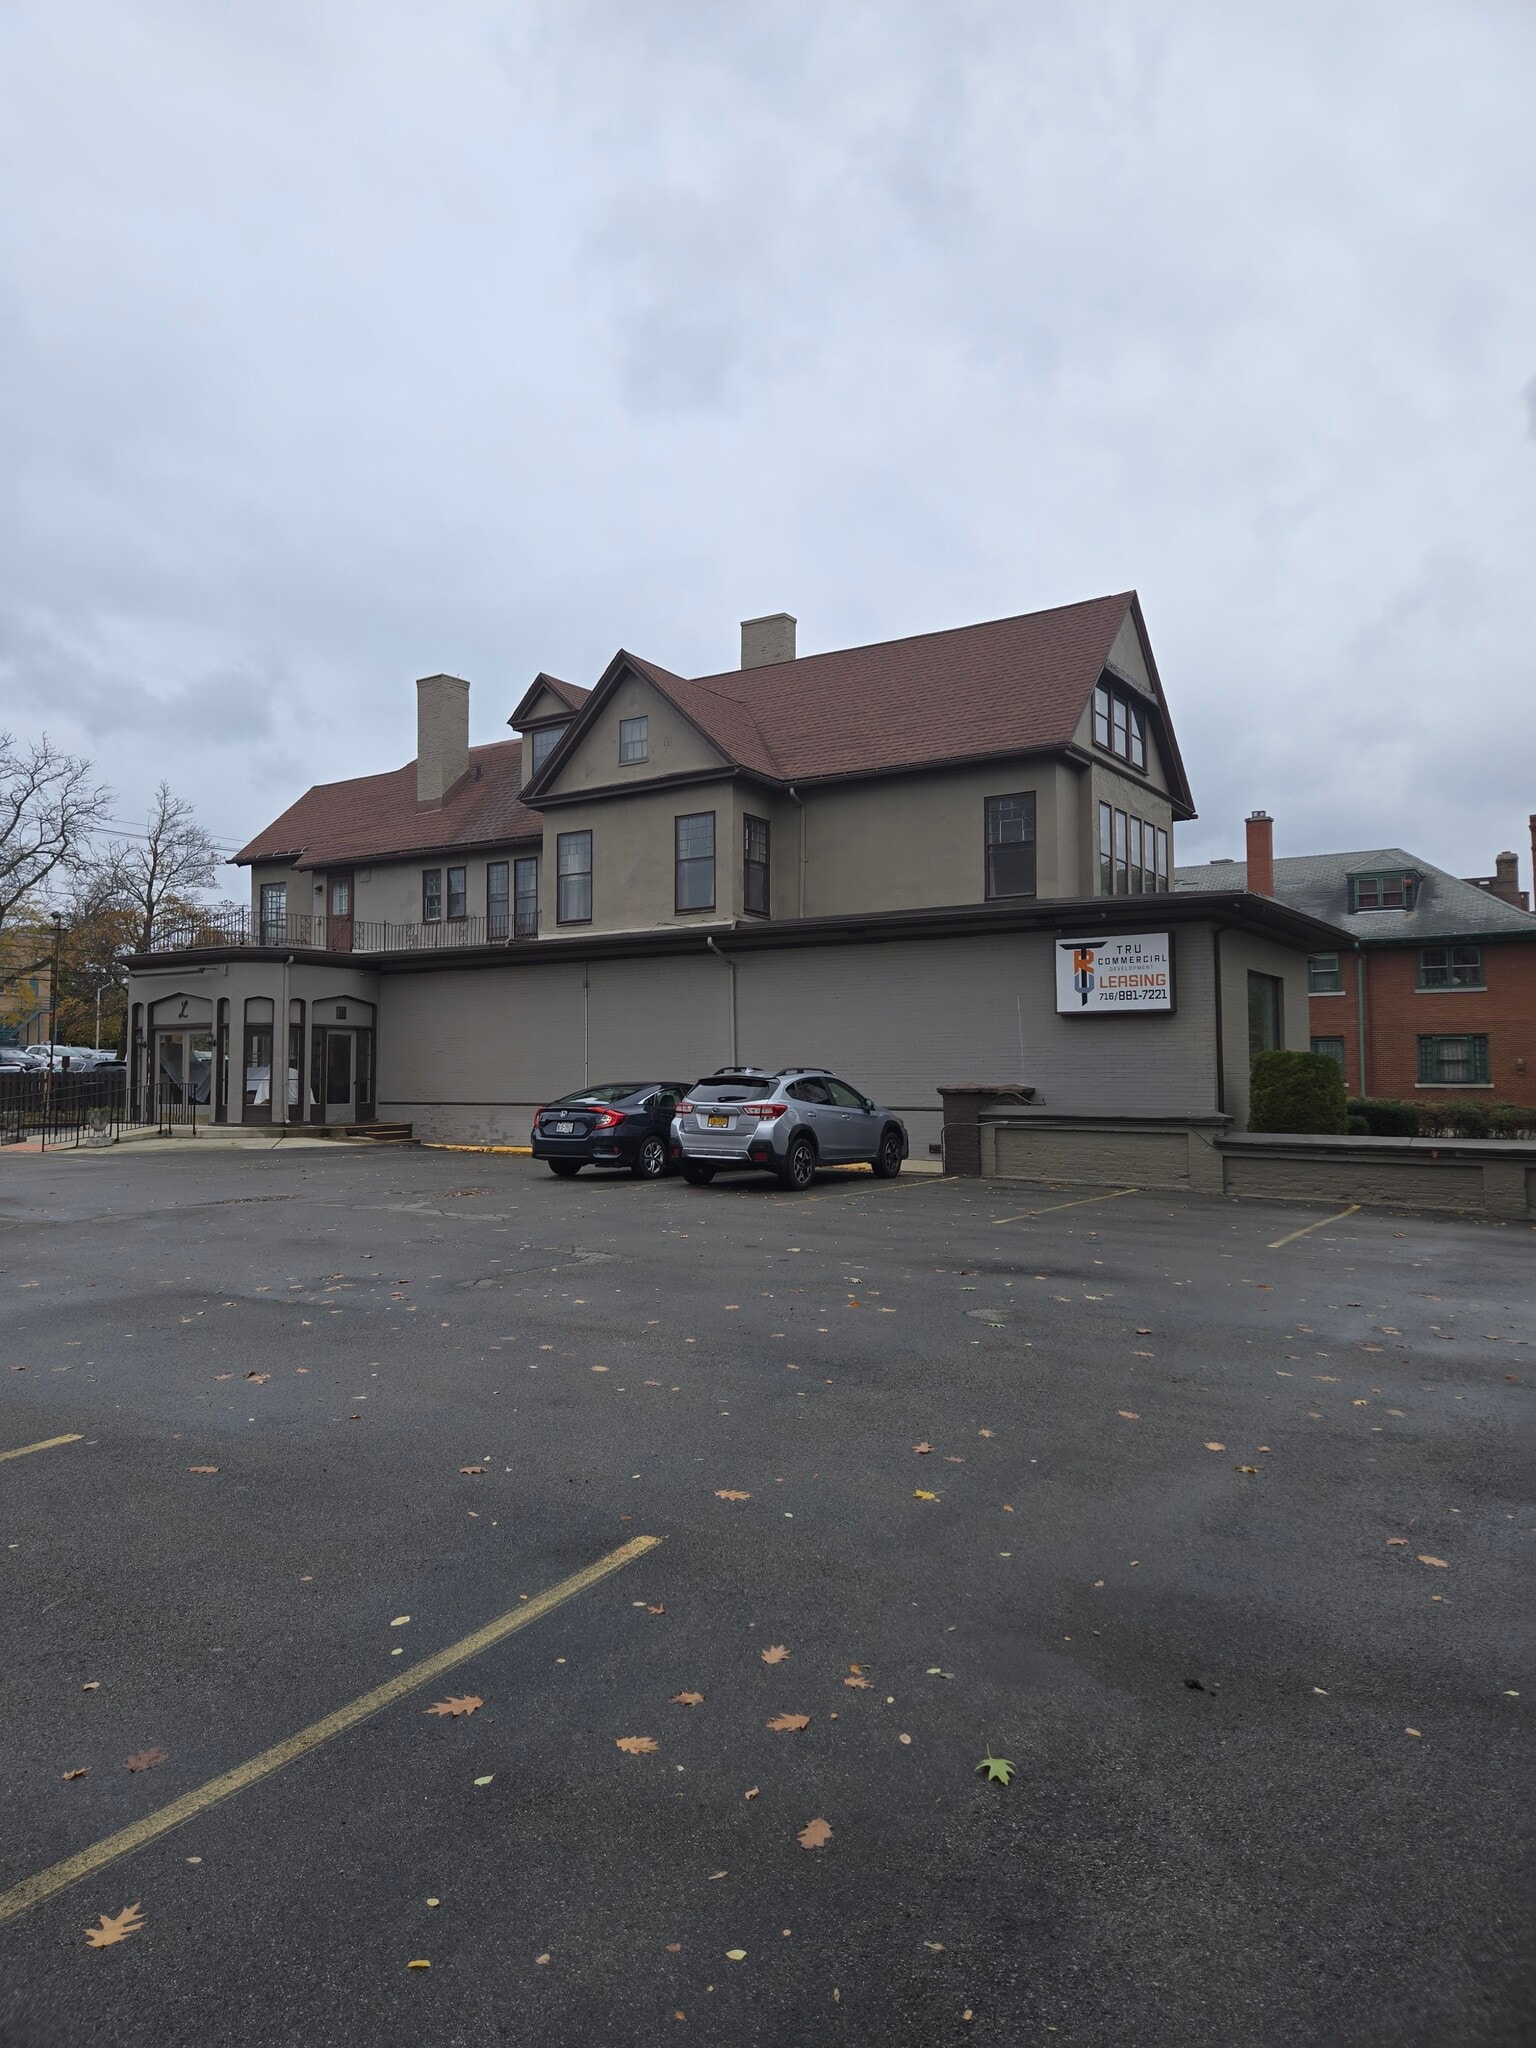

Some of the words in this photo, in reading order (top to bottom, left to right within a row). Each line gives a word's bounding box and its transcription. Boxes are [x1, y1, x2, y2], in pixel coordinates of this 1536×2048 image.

[1116, 944, 1142, 954] TRU
[1098, 954, 1167, 966] COMMERCIAL
[1099, 973, 1166, 988] LEASING
[1099, 989, 1167, 1001] 716/881-7221
